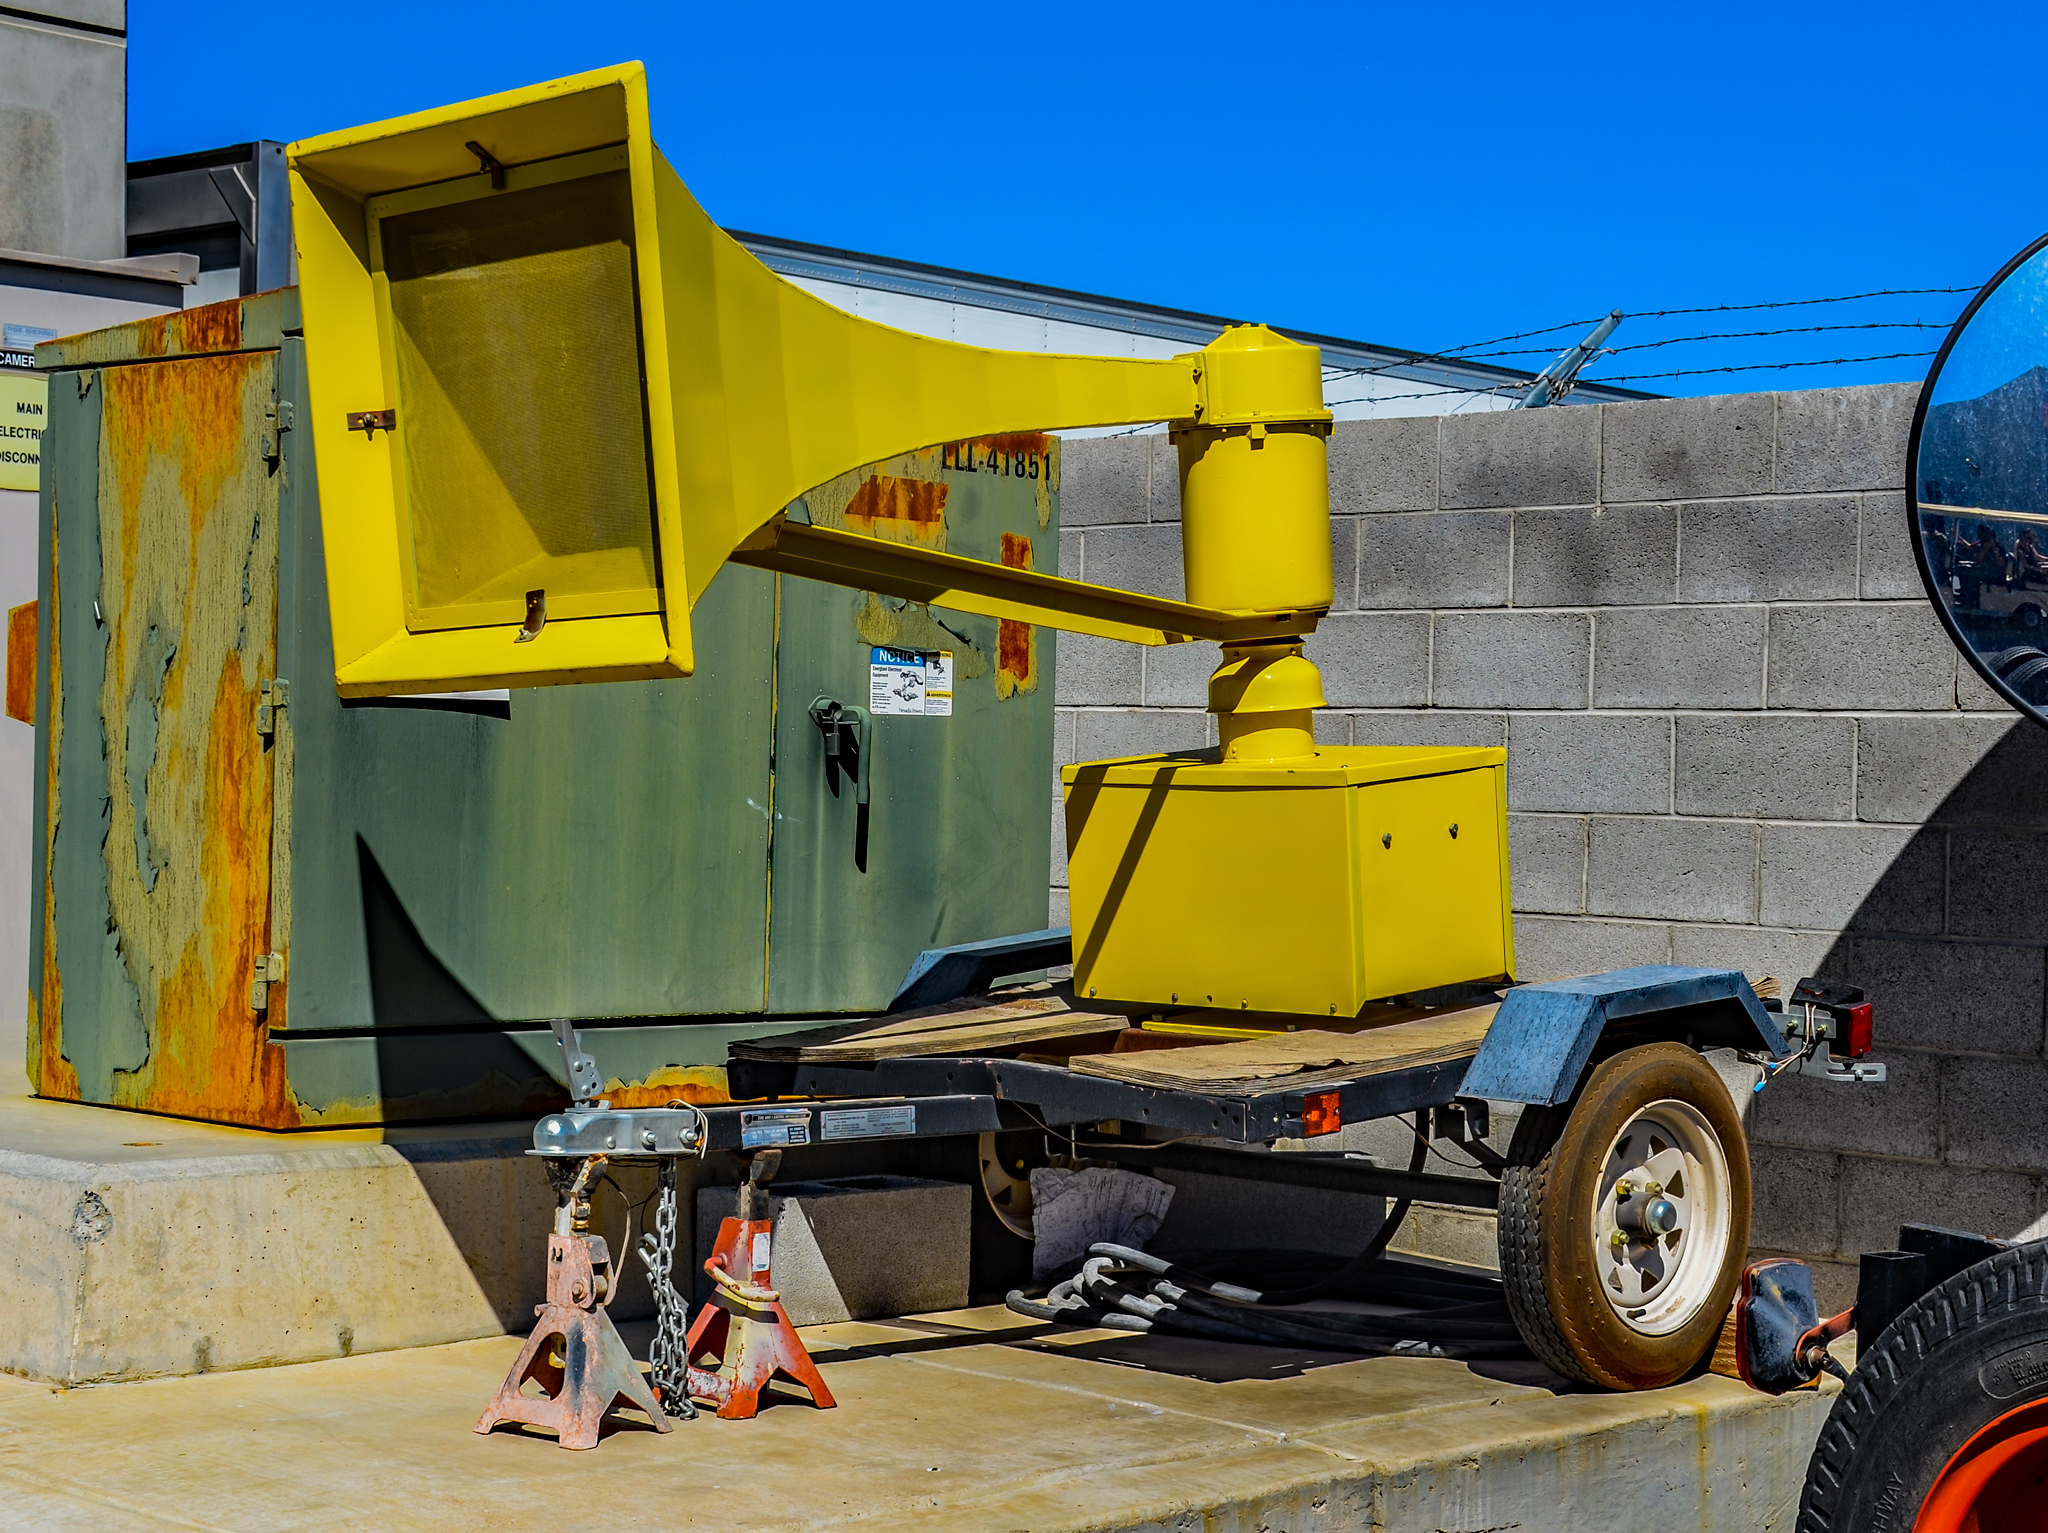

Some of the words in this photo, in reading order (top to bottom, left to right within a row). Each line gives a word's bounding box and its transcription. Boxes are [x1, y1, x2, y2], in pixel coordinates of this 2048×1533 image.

[16, 402, 43, 415] MAIN
[0, 450, 41, 465] ISCONN
[879, 649, 920, 664] NOTICE
[1871, 1470, 1904, 1533] HWAY
